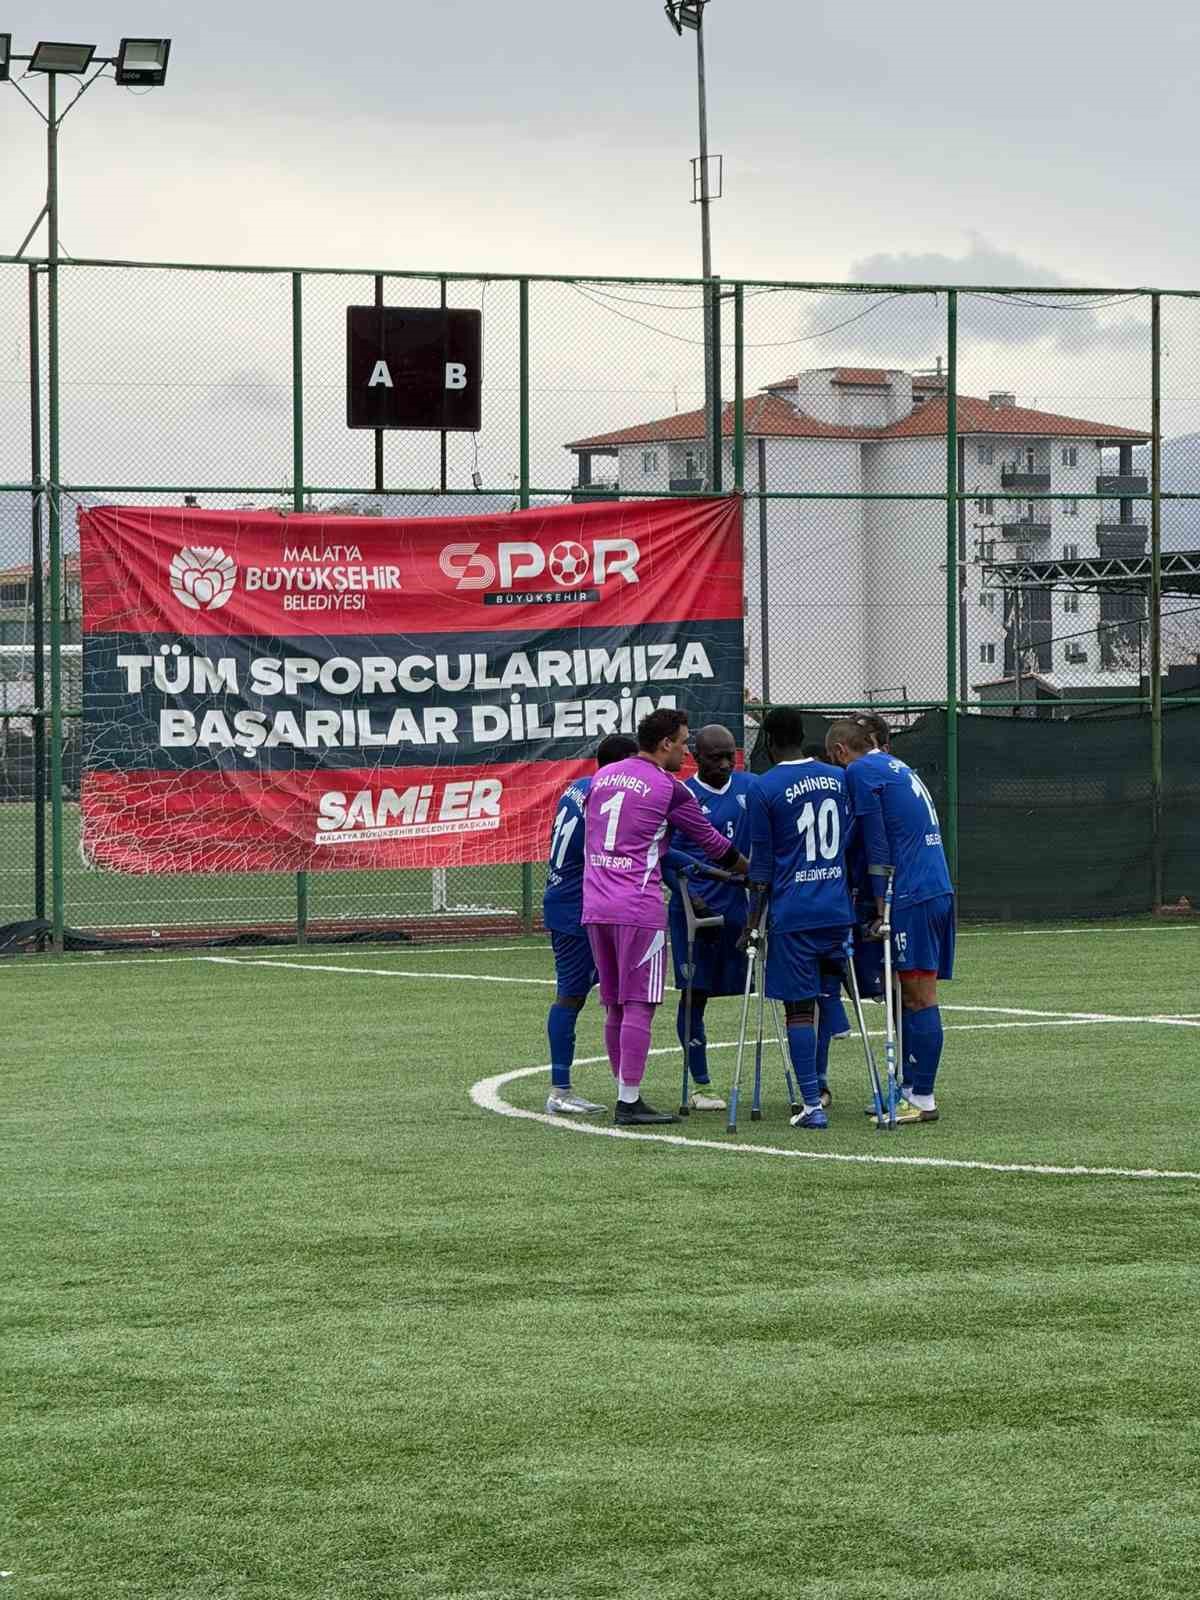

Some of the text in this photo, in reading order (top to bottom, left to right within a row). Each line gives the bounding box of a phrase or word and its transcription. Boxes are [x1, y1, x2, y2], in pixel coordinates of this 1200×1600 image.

[367, 360, 394, 388] A
[445, 362, 467, 390] B
[283, 544, 363, 562] MALATYA
[439, 538, 641, 590] SPOR
[245, 564, 401, 593] BÜYÜKŞEHİR
[283, 593, 366, 611] BELEDİYESİ
[116, 641, 714, 697] TÜM SPORCULARIMIZA
[159, 705, 459, 758] BAŞARILAR
[438, 778, 504, 822] ER
[785, 775, 841, 805] ŞAHİNBEY
[600, 791, 626, 852] 1
[725, 820, 734, 839] 5
[796, 798, 841, 862] 10
[319, 832, 358, 842] MALATYA
[550, 805, 579, 869] 11
[894, 931, 908, 952] 15
